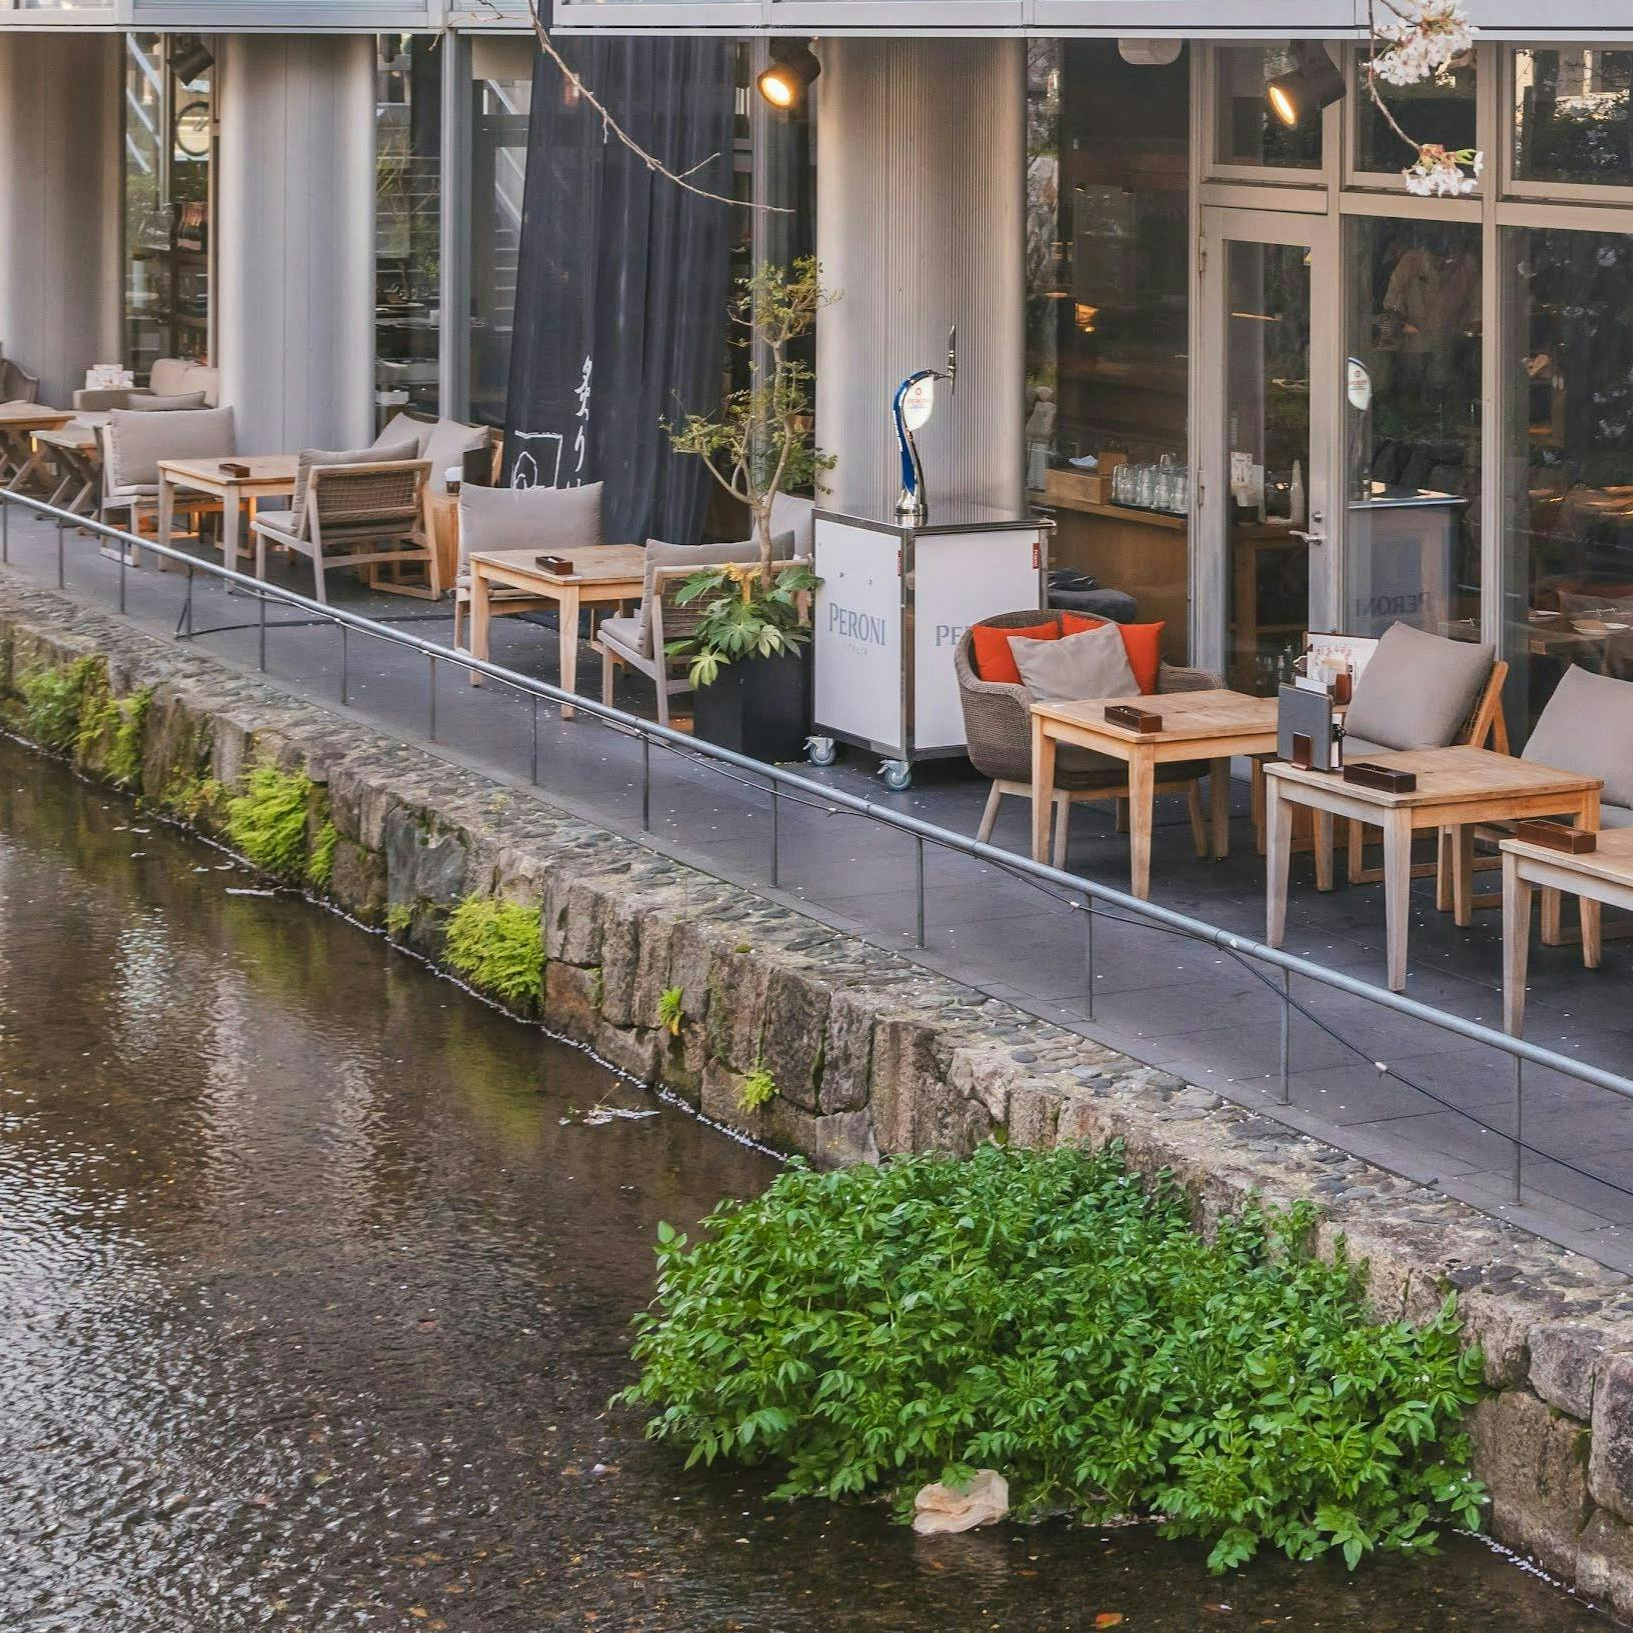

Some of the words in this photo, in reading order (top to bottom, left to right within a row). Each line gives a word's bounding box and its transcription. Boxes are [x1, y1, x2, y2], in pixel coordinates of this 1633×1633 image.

[567, 355, 593, 487] 炙り
[829, 602, 886, 646] PERONI
[935, 624, 972, 647] PE
